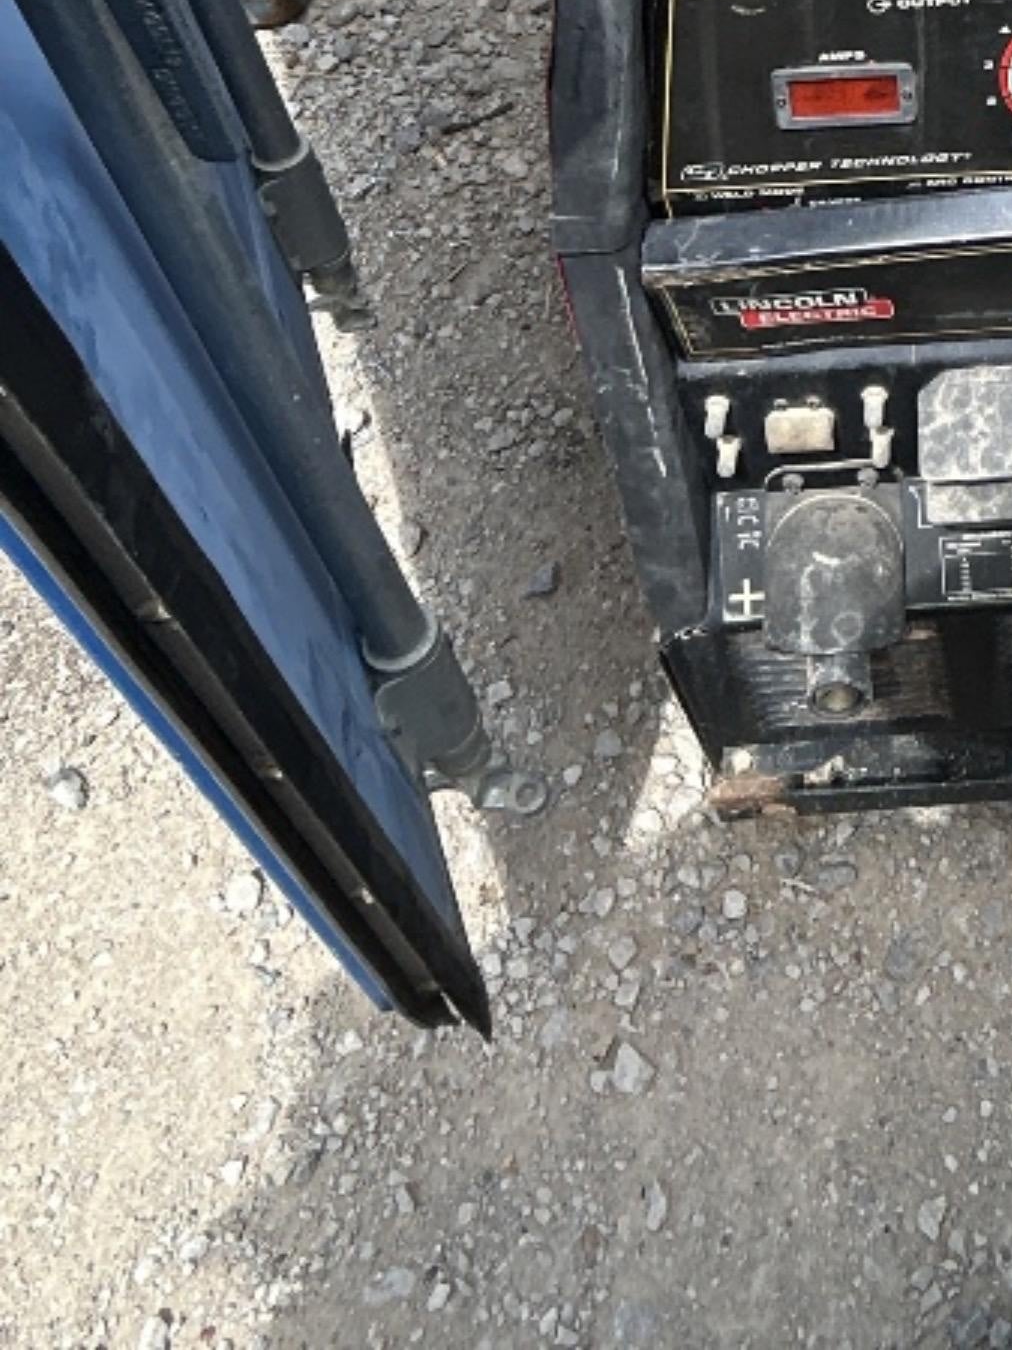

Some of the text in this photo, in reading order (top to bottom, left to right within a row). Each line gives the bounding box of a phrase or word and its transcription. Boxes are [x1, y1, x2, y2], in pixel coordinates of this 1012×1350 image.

[818, 50, 866, 62] AMPS
[720, 289, 859, 312] LINCOLN
[759, 305, 878, 325] ELECTRIC
